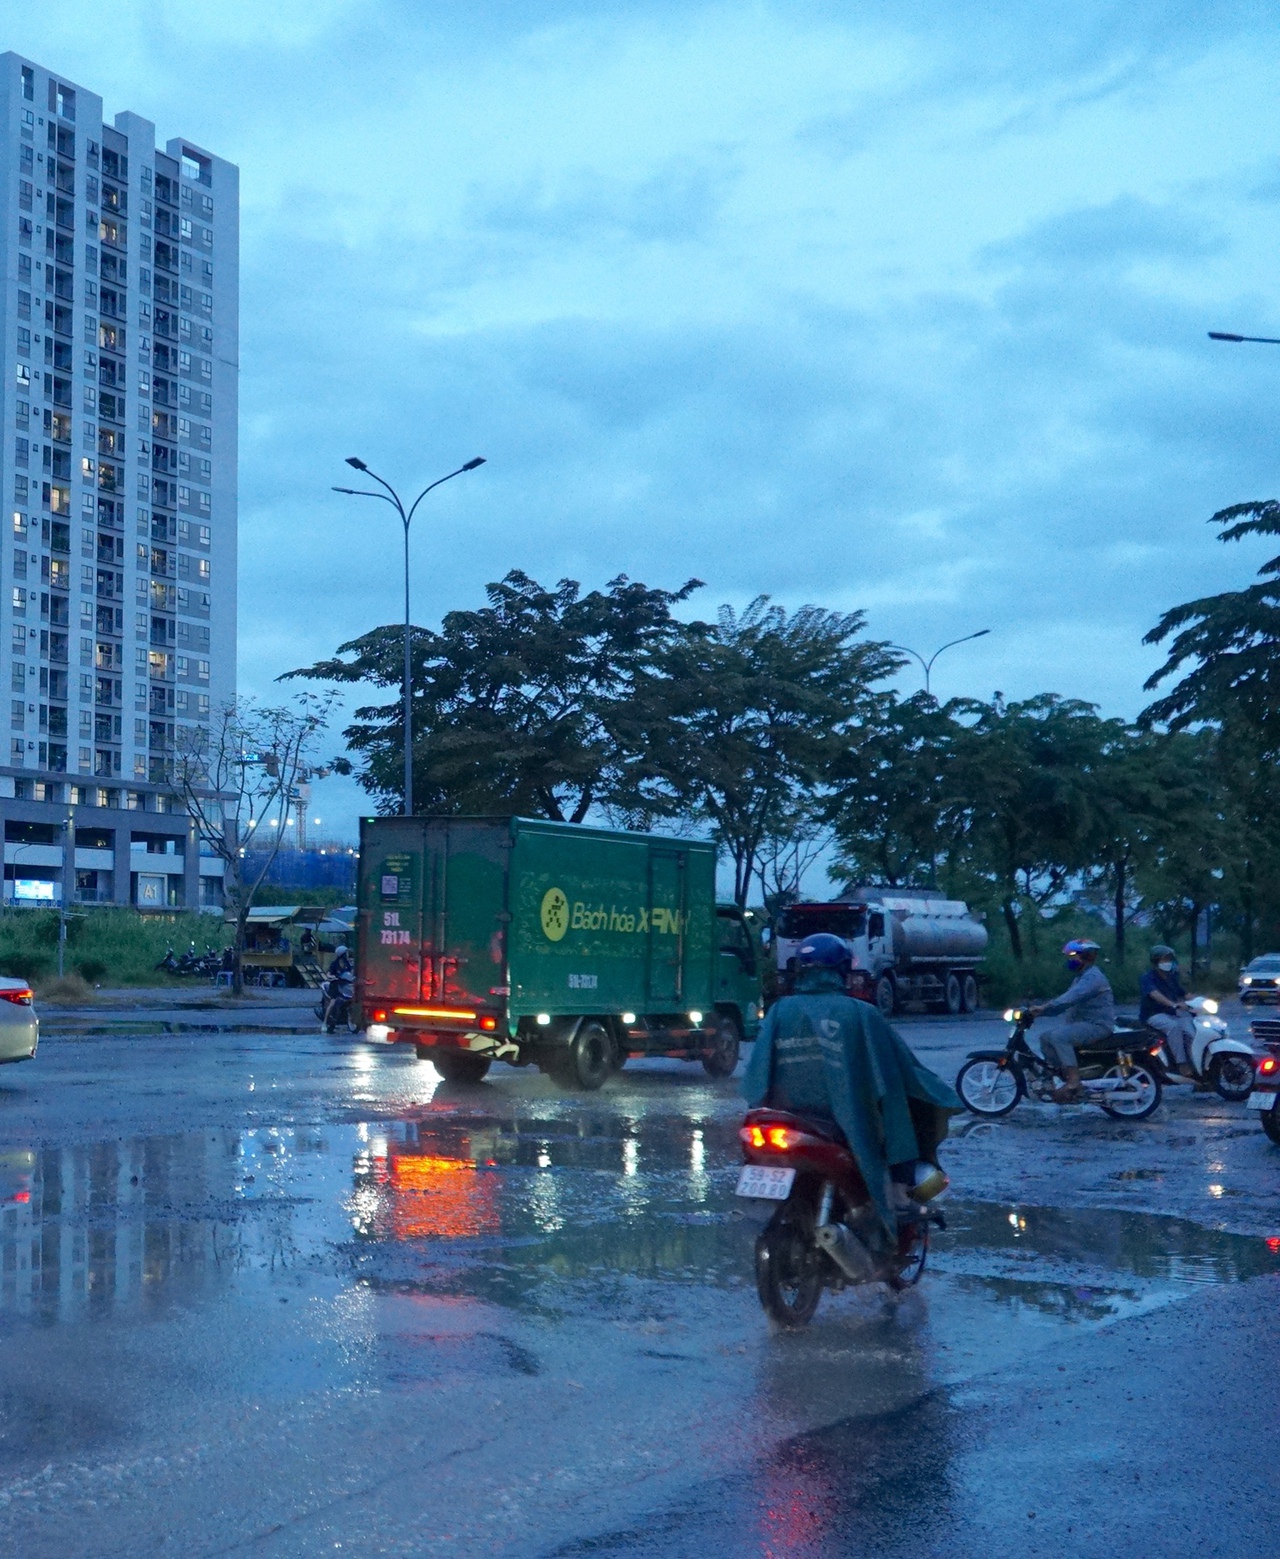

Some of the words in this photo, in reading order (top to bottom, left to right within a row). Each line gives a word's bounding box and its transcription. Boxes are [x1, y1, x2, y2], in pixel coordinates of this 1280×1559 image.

[144, 884, 157, 899] A1
[571, 902, 608, 930] Bách
[609, 904, 636, 932] hóa
